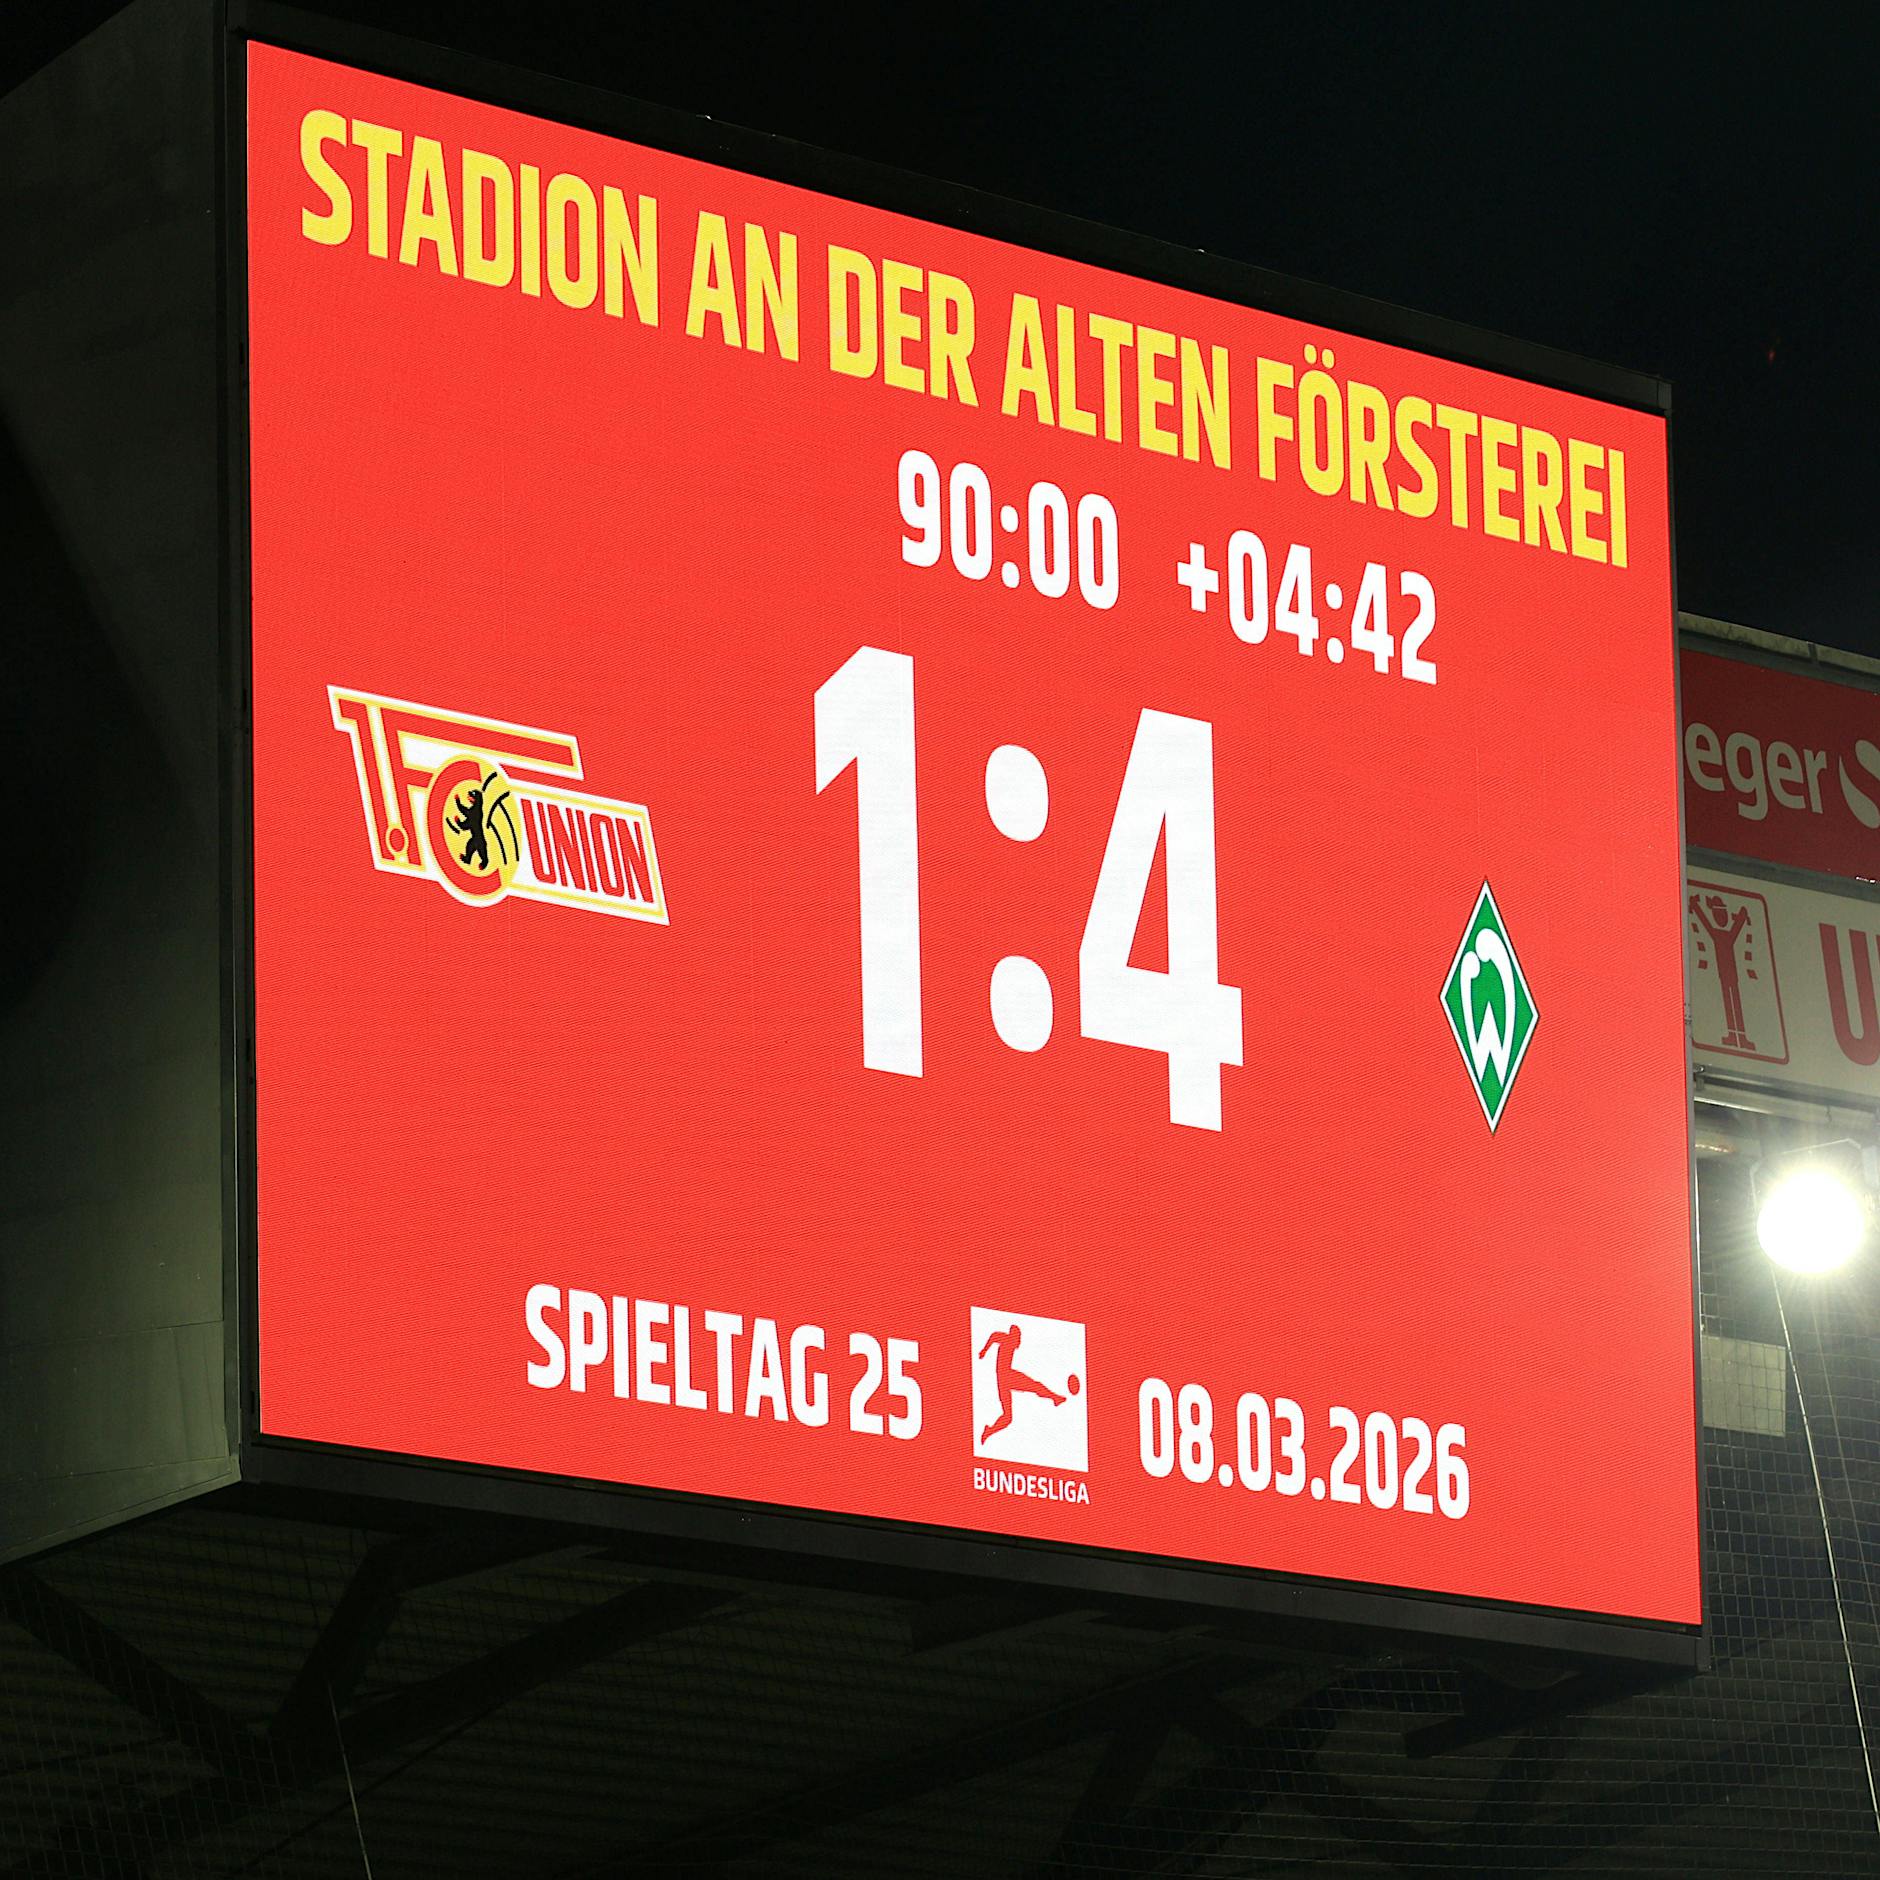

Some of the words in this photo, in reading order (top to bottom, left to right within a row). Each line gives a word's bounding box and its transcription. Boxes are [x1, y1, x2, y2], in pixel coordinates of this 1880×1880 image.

[300, 109, 659, 327] STADION
[685, 210, 799, 362] AN
[828, 244, 979, 407] DER
[1001, 292, 1231, 470] ALTEN
[1256, 343, 1628, 569] FÖRSTEREI
[897, 449, 1119, 610] 90:00
[1177, 529, 1437, 685] +04:42
[1684, 722, 1824, 822] eger
[520, 798, 655, 904] UNION
[813, 645, 1244, 1132] 1:4
[1818, 922, 1880, 1067] U
[525, 1283, 829, 1427] SPIELTAG
[849, 1332, 923, 1440] 25
[973, 1467, 1090, 1505] BUNDESLIGA
[1138, 1377, 1470, 1520] 08.03.2026
